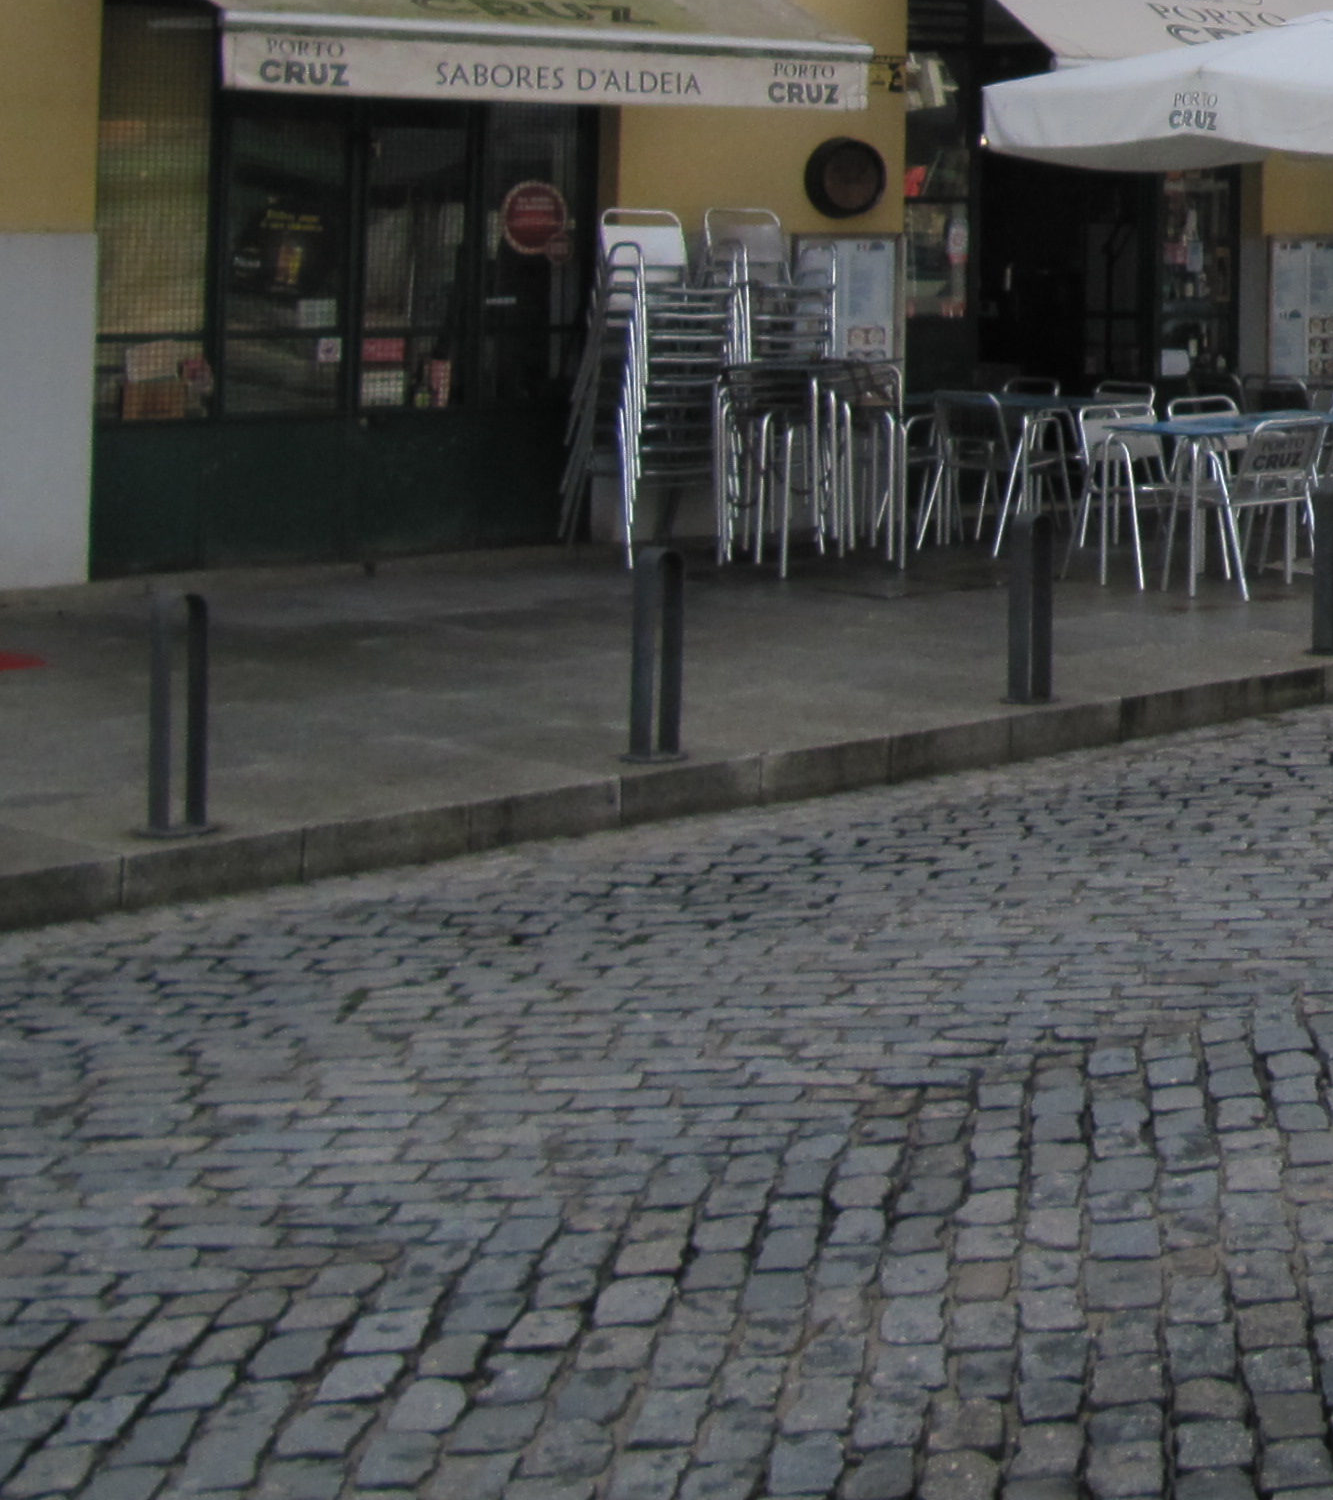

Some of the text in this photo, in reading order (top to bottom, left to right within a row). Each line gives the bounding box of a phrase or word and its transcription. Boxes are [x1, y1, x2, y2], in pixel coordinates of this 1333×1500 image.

[1147, 2, 1288, 28] PORTO
[265, 36, 345, 58] PORTO
[258, 58, 350, 88] CRUZ
[435, 60, 703, 96] SABORES D'ALDEIA
[772, 61, 836, 80] PORTO
[767, 81, 840, 105] CRUZ
[1173, 91, 1219, 108] PORTO
[1168, 109, 1218, 131] CRUZ
[1252, 450, 1304, 470] CRUZ
